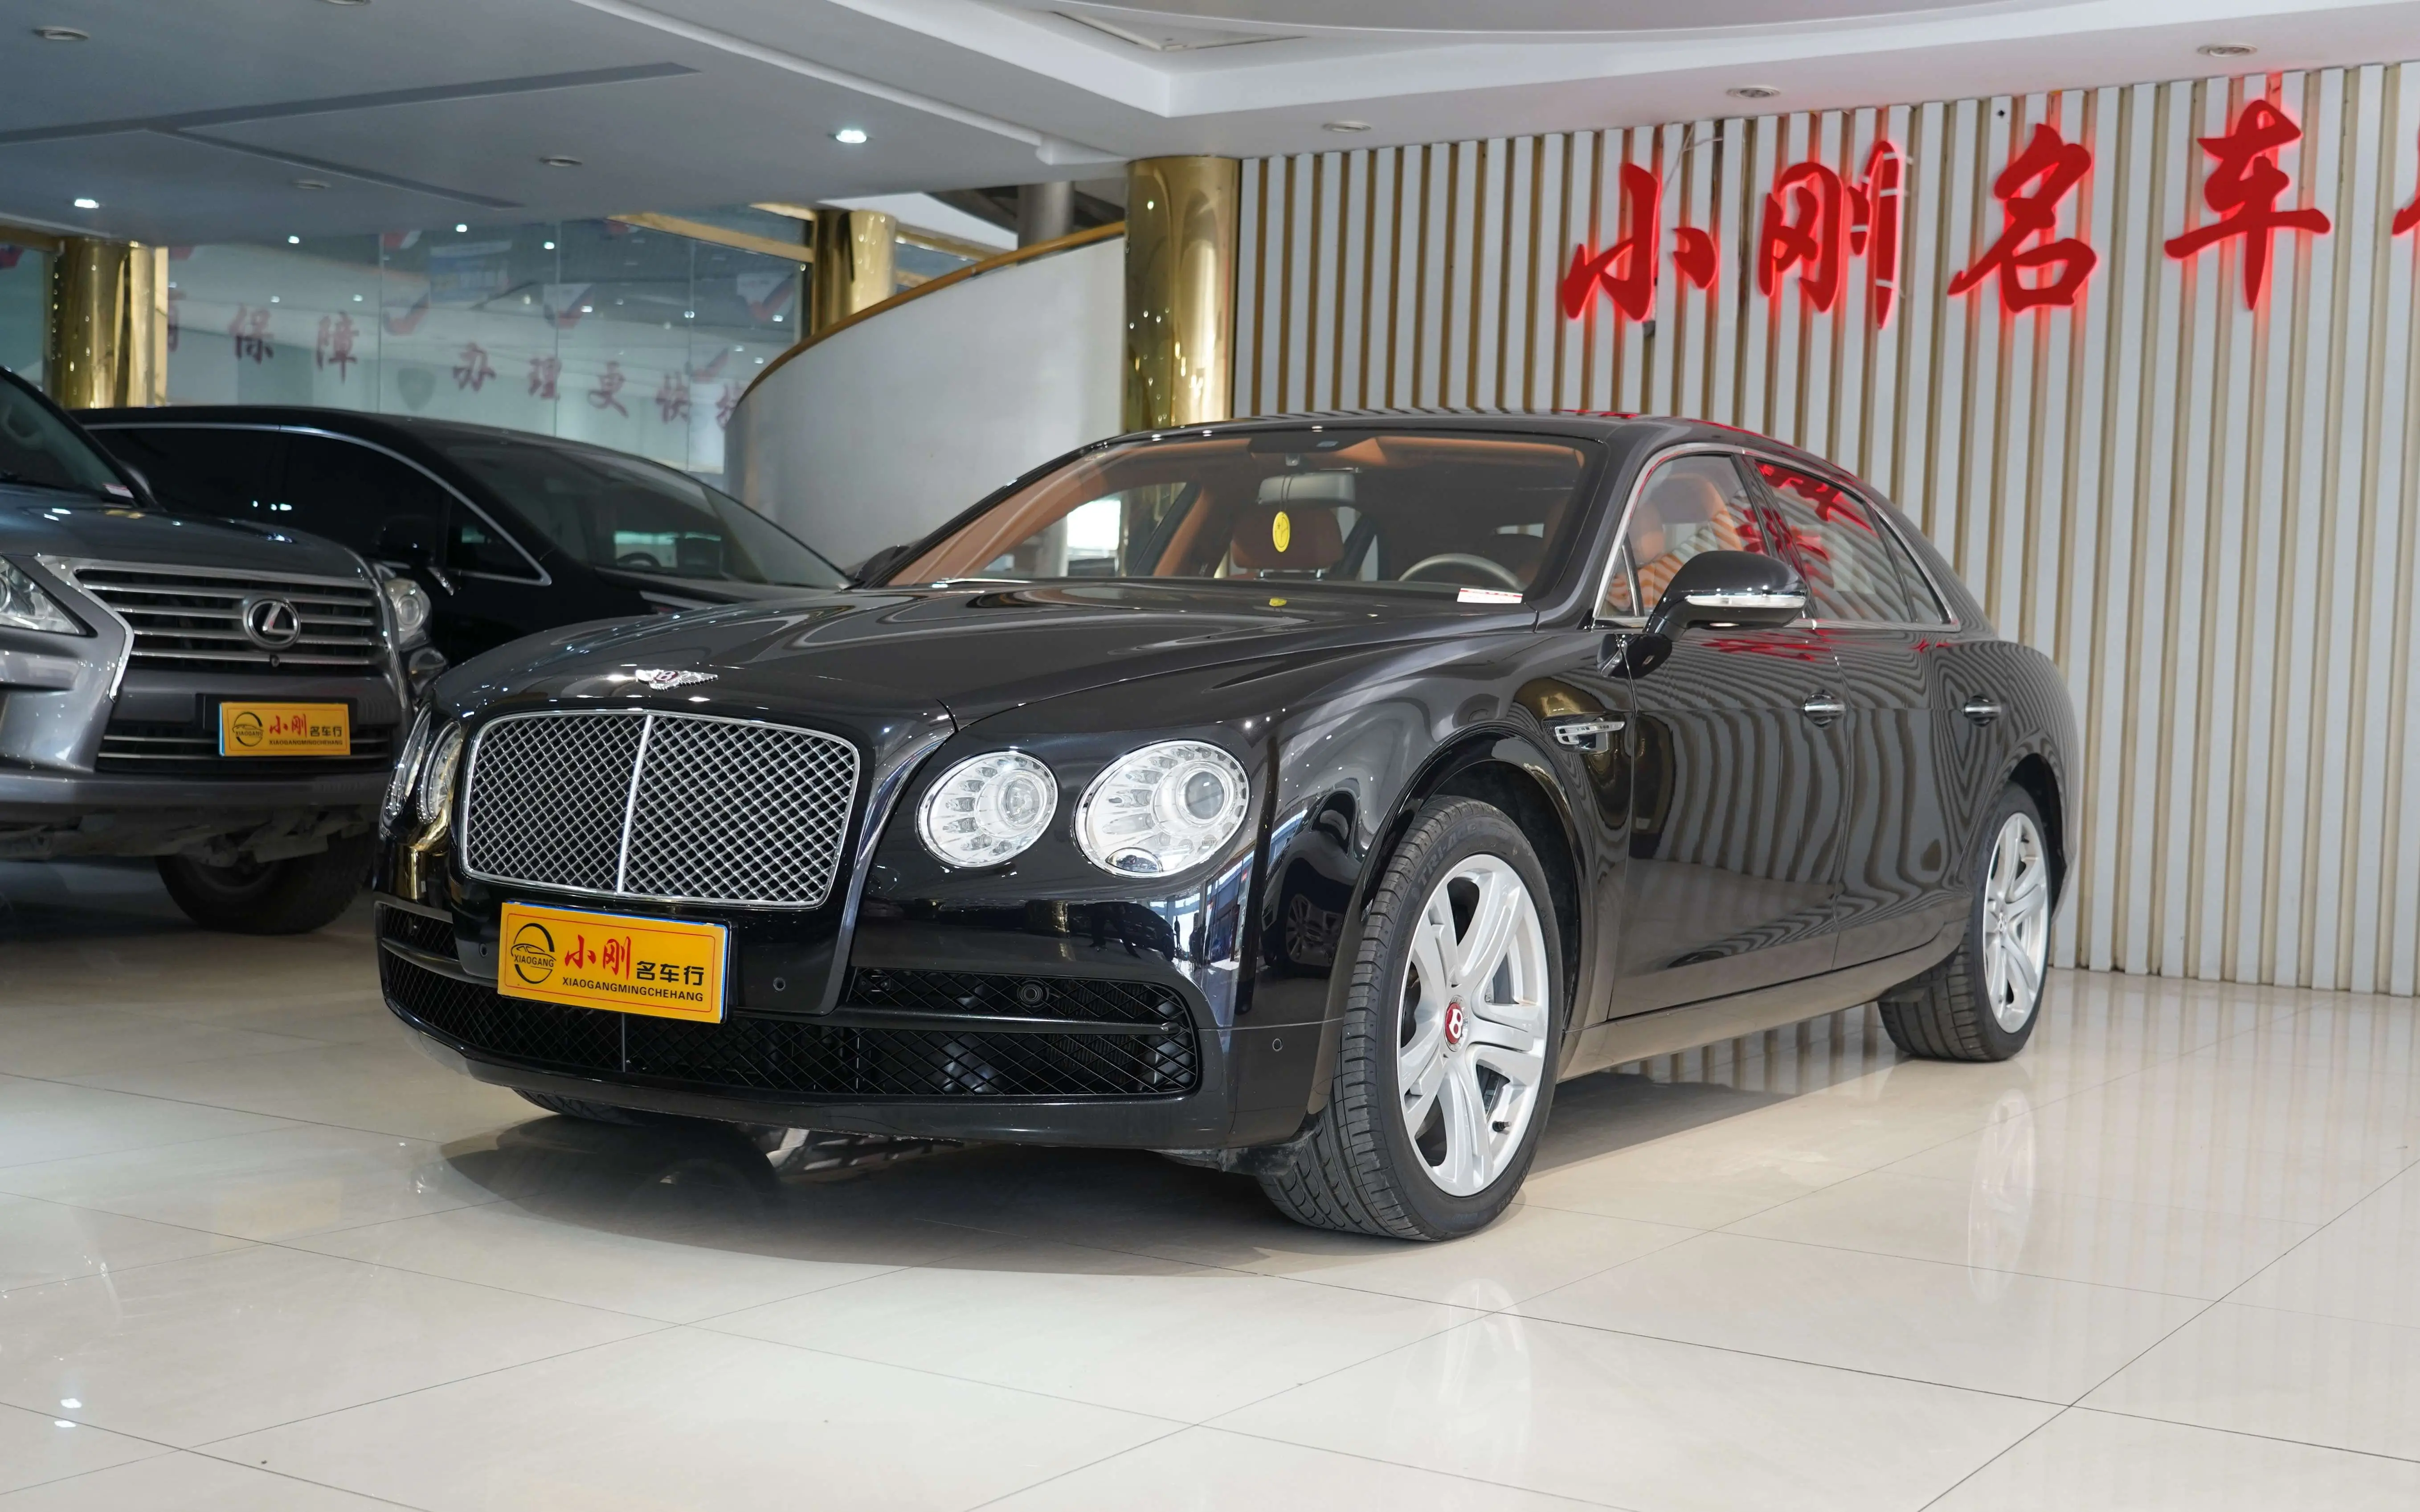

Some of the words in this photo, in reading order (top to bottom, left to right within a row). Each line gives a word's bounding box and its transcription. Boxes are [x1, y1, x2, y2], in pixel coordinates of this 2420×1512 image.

[1563, 99, 2420, 328] 小刚名车
[513, 954, 555, 968] XIAOGANG
[562, 977, 704, 1002] XIAOGANGMINGCHEHANG
